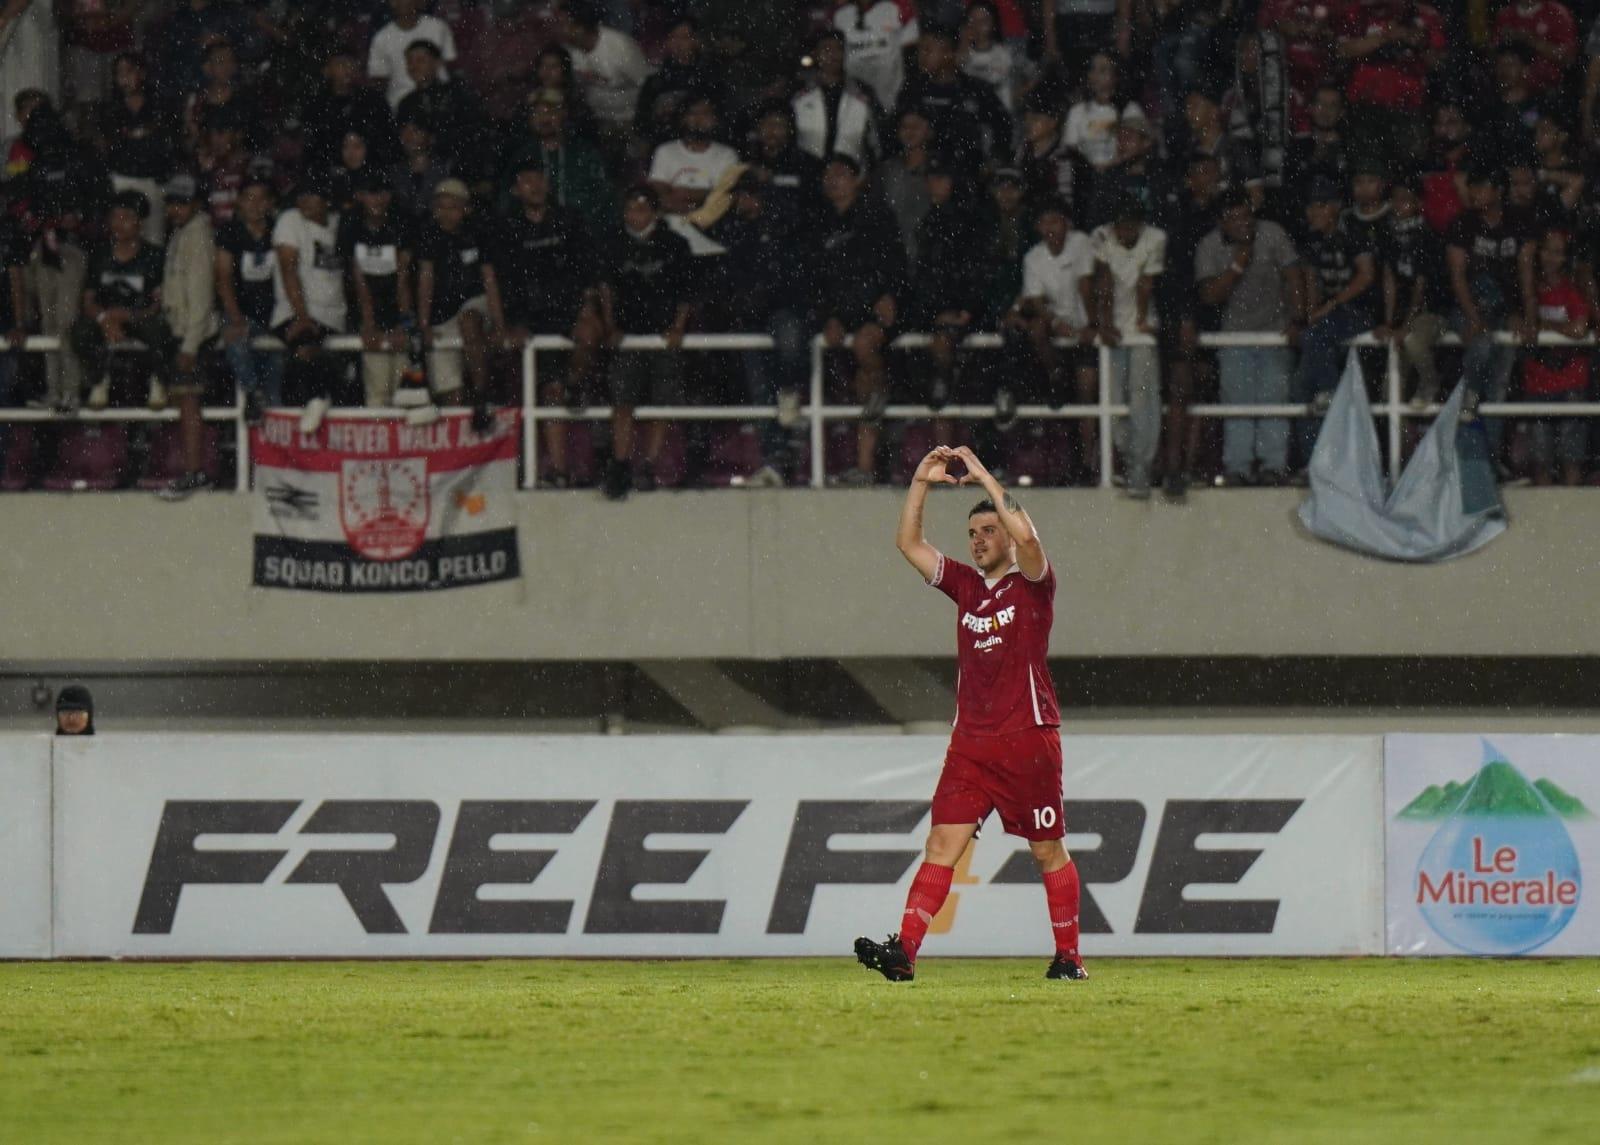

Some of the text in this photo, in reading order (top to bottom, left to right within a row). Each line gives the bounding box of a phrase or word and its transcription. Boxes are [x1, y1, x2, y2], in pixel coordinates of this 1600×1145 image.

[328, 422, 389, 453] NEVER
[398, 421, 451, 450] WALK
[263, 551, 506, 586] SQUAD KONCO PELLO
[1033, 806, 1056, 829] 10
[131, 799, 753, 935] FREE
[1473, 836, 1517, 874] Le
[1416, 869, 1578, 905] Minerale
